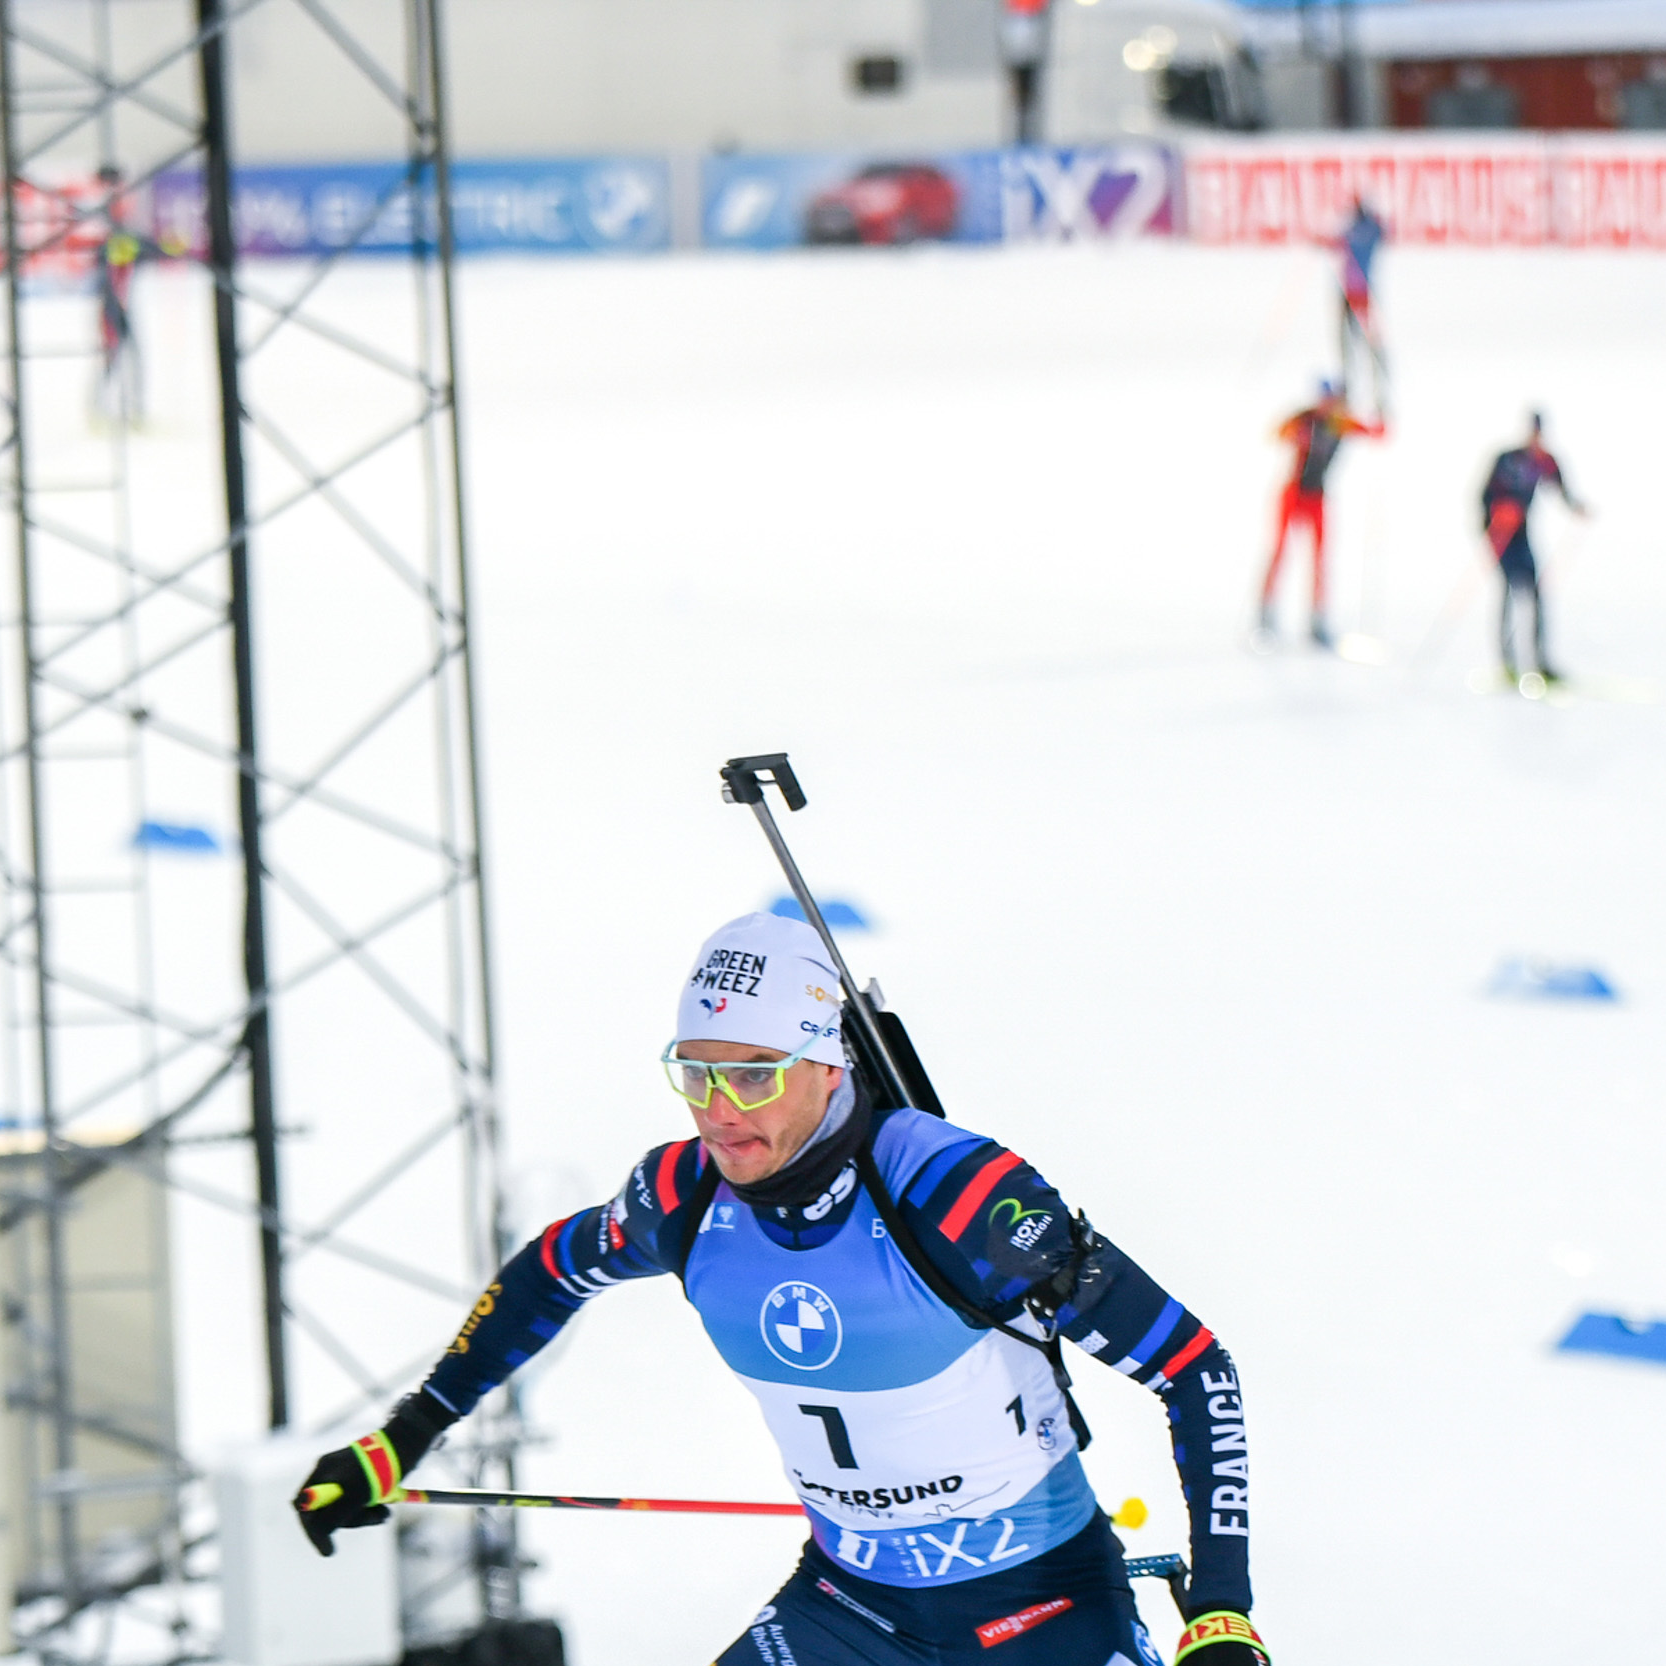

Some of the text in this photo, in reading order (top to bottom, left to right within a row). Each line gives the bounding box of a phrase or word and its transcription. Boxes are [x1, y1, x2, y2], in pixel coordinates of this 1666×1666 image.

[706, 949, 767, 976] GREEN
[797, 1403, 860, 1470] 1
[1005, 1394, 1027, 1437] 1
[1200, 1370, 1249, 1537] FRANCE
[904, 1517, 1030, 1578] iX2
[1189, 1616, 1252, 1642] EKI
